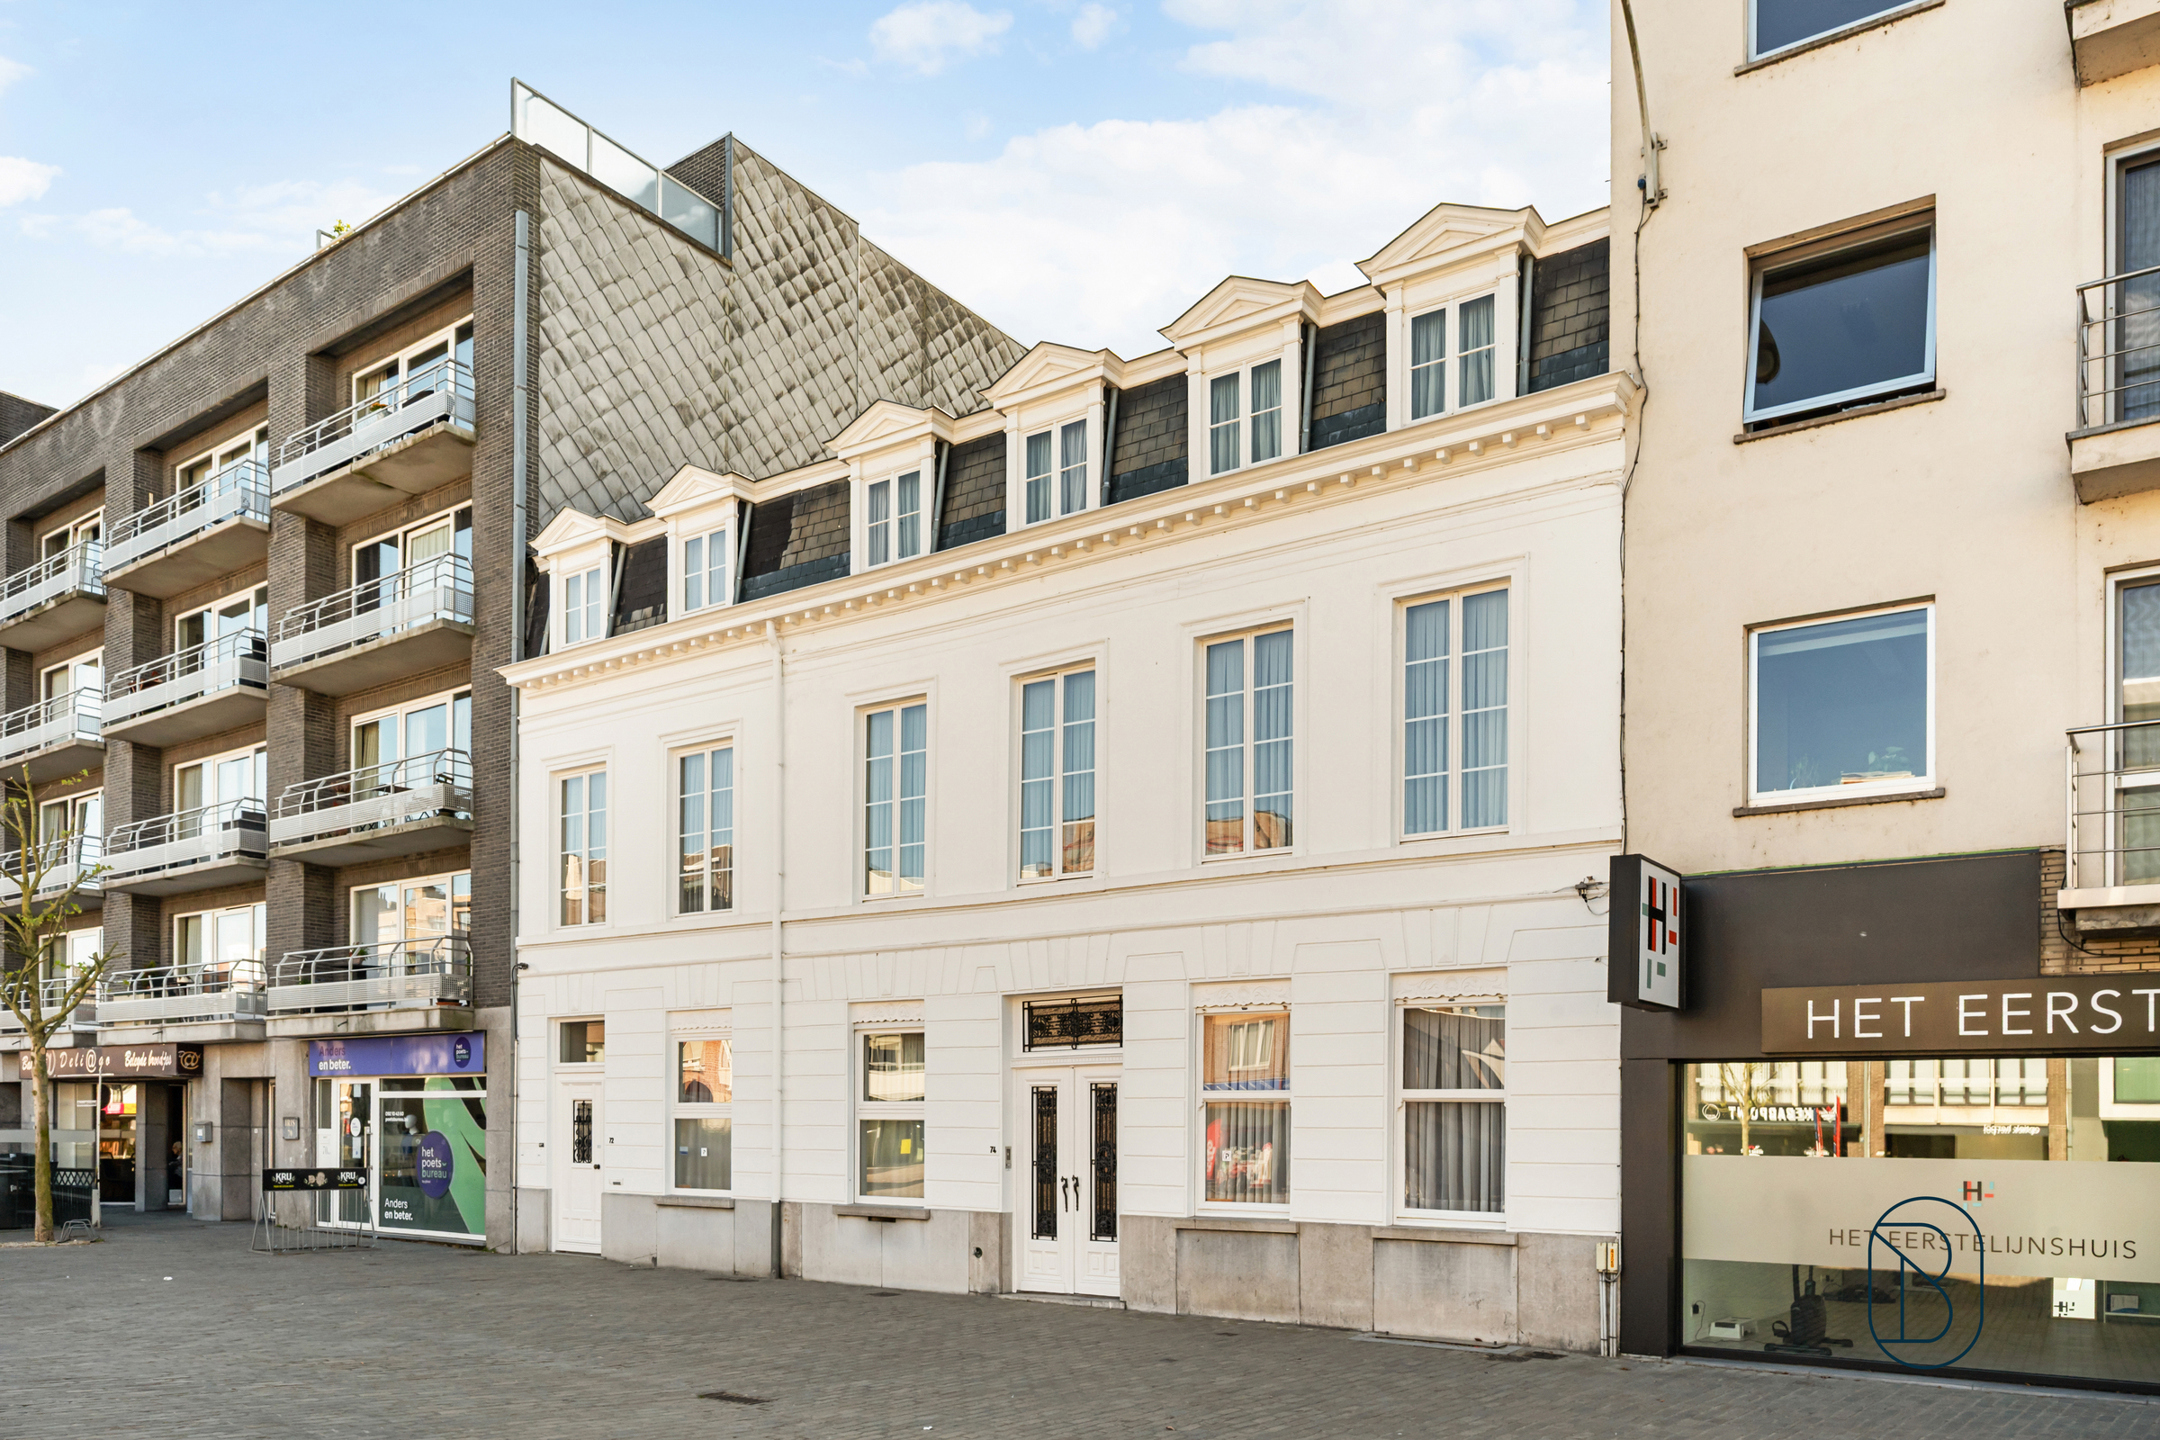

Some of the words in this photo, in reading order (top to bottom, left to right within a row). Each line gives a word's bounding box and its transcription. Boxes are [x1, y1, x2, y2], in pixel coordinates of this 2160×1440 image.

[1807, 996, 1925, 1039] HET
[1958, 988, 2160, 1036] EERST
[318, 1045, 346, 1057] Anders
[124, 1050, 147, 1072] Belegde
[318, 1060, 329, 1071] en
[329, 1058, 351, 1071] beter.
[421, 1146, 434, 1158] het
[421, 1158, 442, 1170] poets
[275, 1172, 293, 1183] KRU
[340, 1171, 356, 1182] KRU
[421, 1169, 447, 1179] bureau
[384, 1197, 409, 1209] Anders
[384, 1210, 393, 1219] en
[393, 1209, 414, 1221] beter.
[1828, 1228, 1874, 1248] HET
[1888, 1230, 2138, 1260] EERSTELIJNSHUIS
